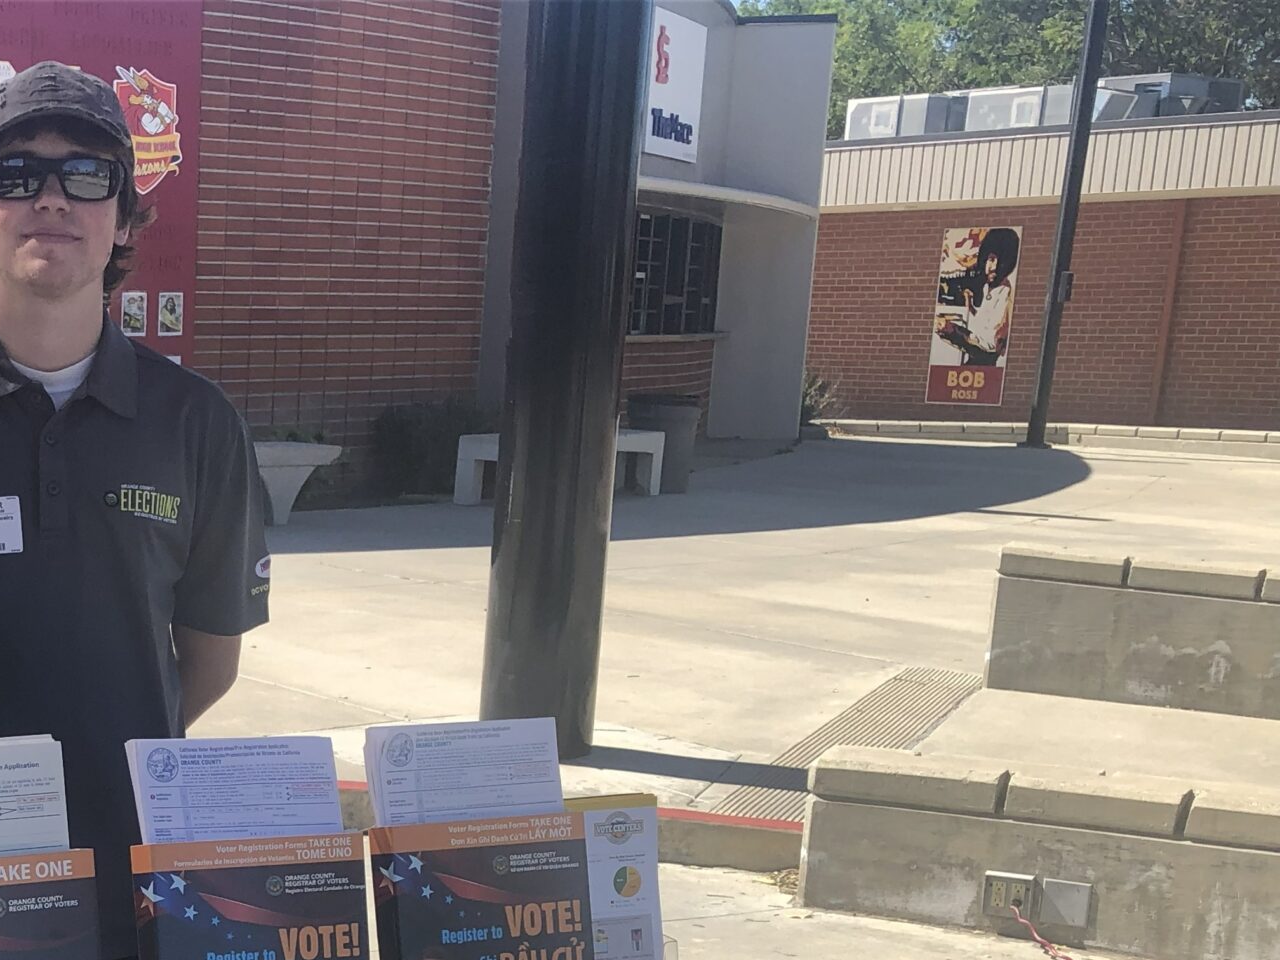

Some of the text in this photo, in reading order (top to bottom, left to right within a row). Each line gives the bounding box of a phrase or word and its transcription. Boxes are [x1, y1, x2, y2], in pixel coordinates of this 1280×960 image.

[946, 370, 986, 388] BOB
[951, 389, 979, 401] ROSS
[120, 489, 181, 519] ELECTIONS
[552, 815, 572, 826] ONE
[296, 848, 328, 861] TOME
[328, 846, 353, 859] UNO
[35, 859, 74, 879] ONE
[441, 899, 583, 945] Register to VOTE!
